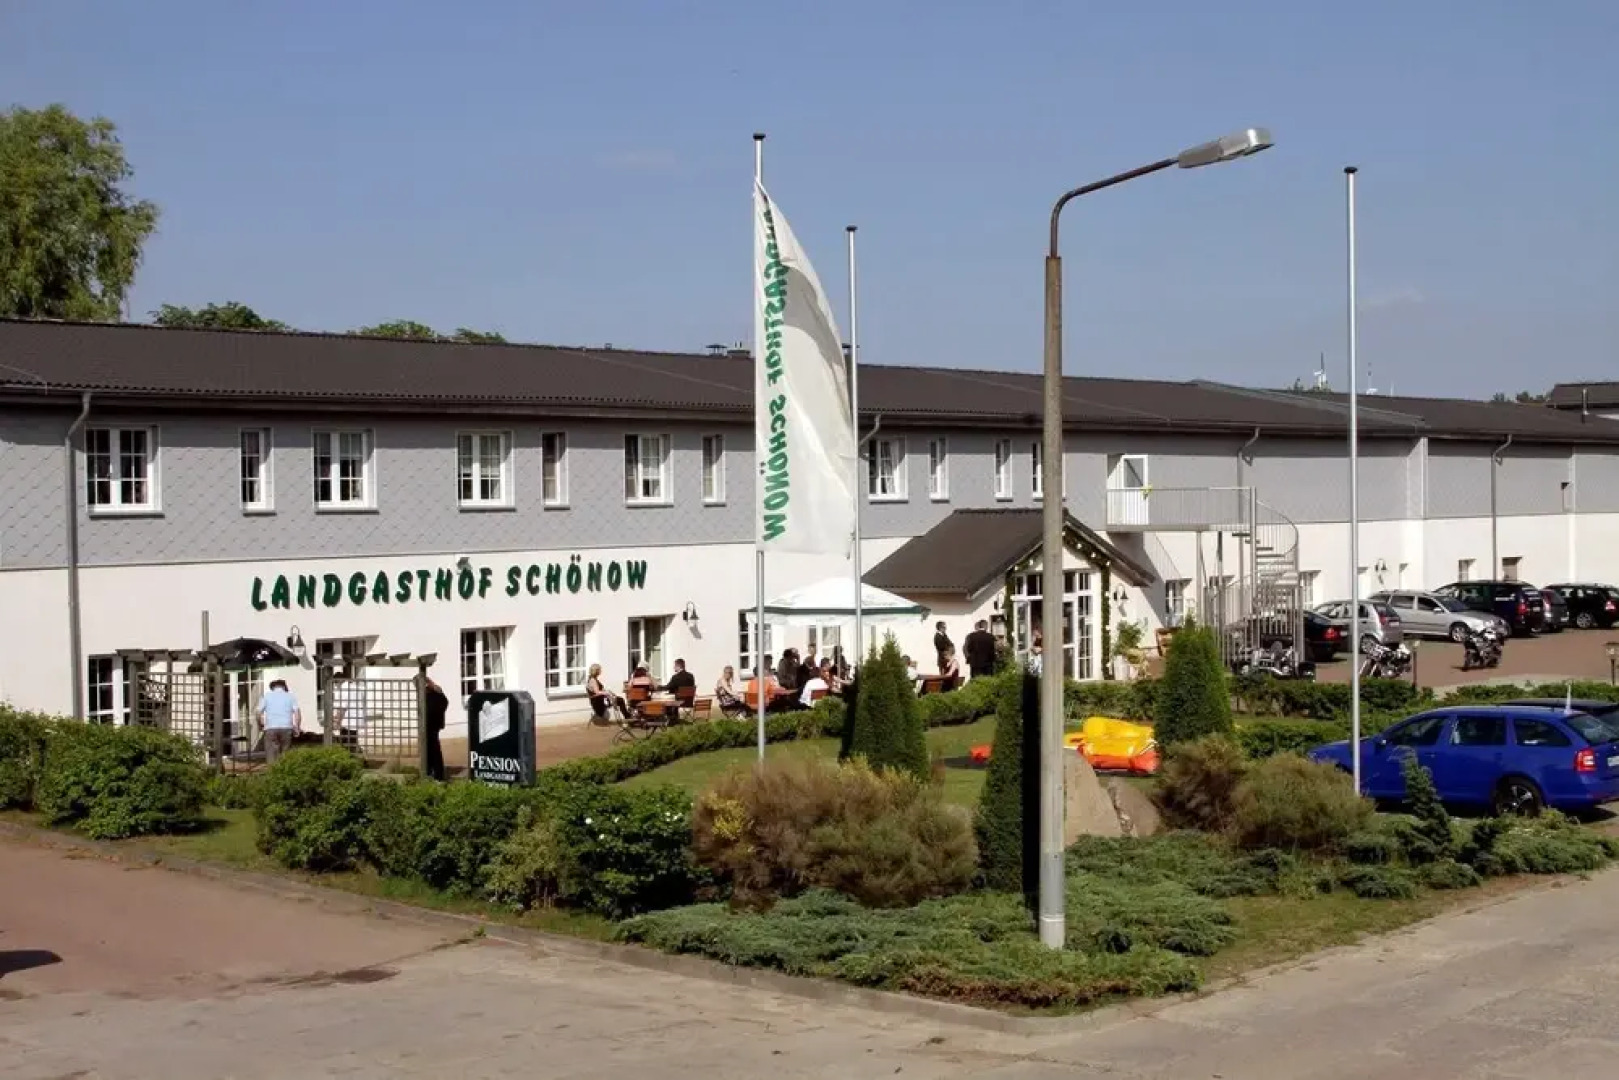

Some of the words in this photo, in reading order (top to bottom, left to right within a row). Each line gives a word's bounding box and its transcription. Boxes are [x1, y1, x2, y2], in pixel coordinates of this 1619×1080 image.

[251, 567, 492, 611] LANDGASTHOF
[505, 554, 647, 598] SCHÖNOW
[470, 750, 520, 773] PENSION
